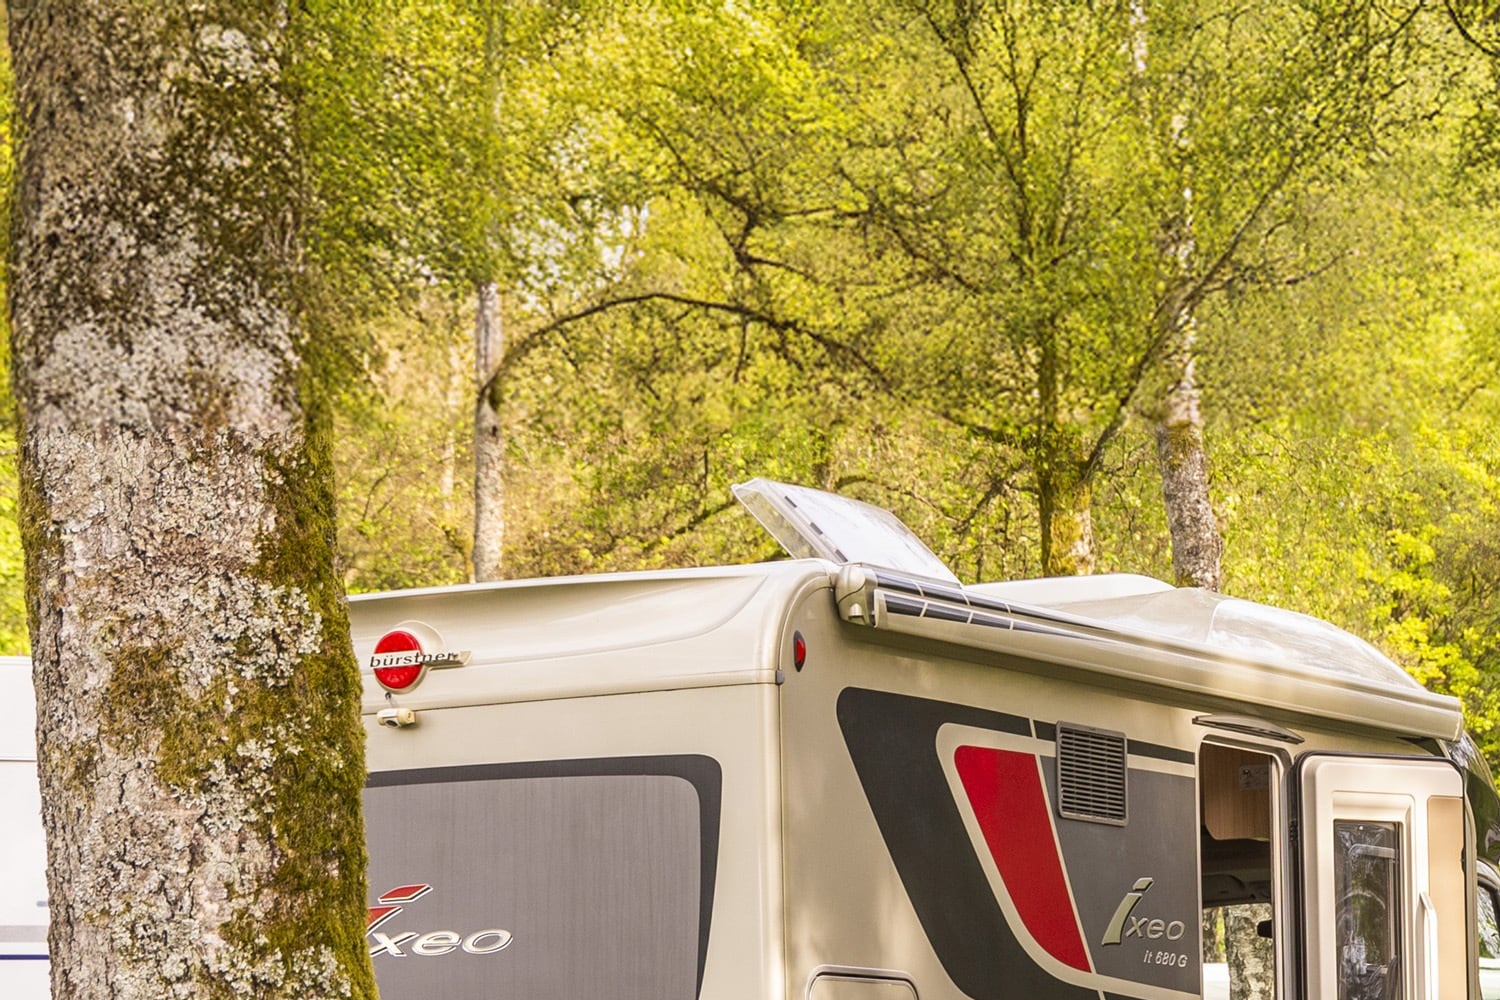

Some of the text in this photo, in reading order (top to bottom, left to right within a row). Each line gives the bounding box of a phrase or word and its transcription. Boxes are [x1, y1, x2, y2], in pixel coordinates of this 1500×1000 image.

[370, 650, 458, 668] bürstner
[1102, 877, 1185, 946] ixeo
[1155, 950, 1176, 967] 680
[1177, 954, 1188, 968] G
